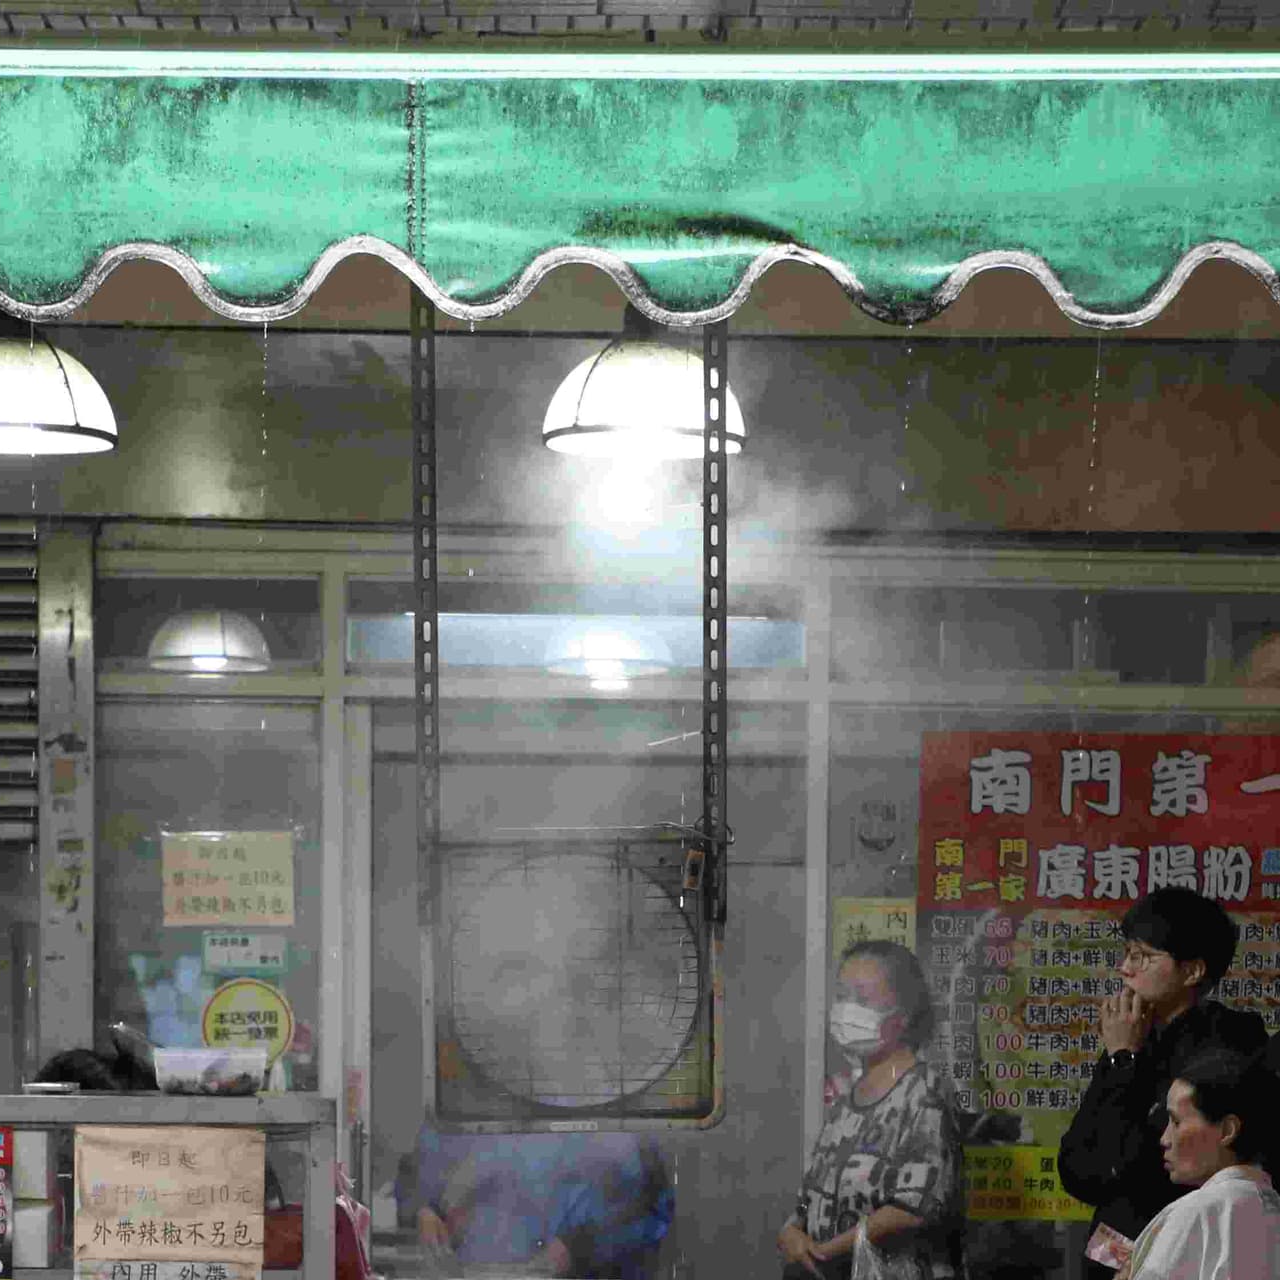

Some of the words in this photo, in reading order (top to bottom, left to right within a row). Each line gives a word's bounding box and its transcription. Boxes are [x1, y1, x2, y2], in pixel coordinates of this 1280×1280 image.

[1036, 843, 1252, 902] 廣東腸粉
[92, 1220, 253, 1246] 外帶辣椒不另包
